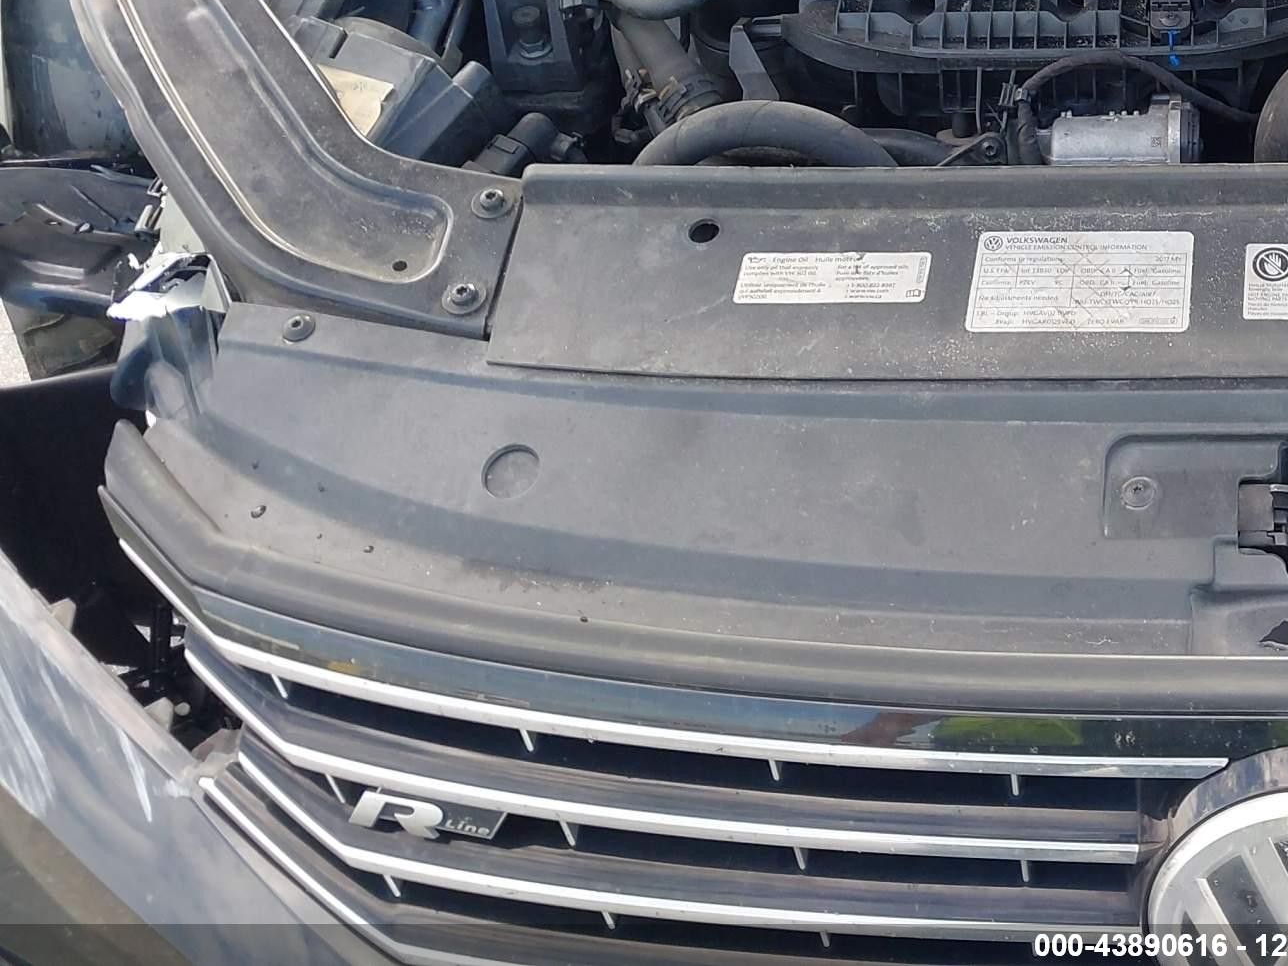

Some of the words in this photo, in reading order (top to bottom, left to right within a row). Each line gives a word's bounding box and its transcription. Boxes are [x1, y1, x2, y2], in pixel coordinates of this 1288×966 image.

[773, 256, 796, 264] Engine
[348, 791, 444, 839] R
[444, 818, 491, 837] Line
